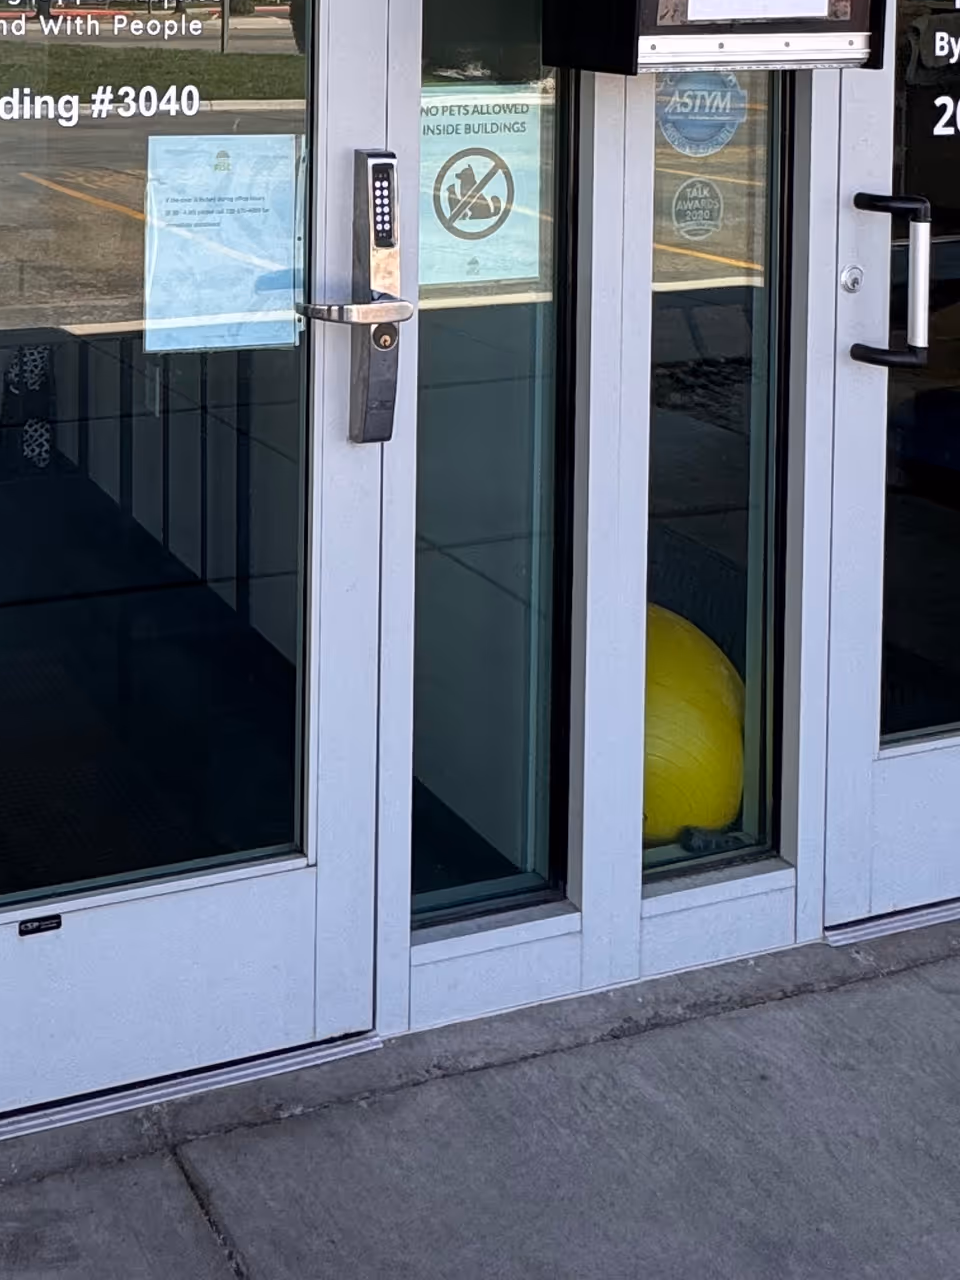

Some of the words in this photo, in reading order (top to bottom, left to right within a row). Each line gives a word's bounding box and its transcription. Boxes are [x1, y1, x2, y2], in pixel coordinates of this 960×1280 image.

[39, 14, 99, 36] With
[114, 14, 202, 40] People
[91, 84, 200, 119] #3040
[420, 105, 439, 117] NO
[441, 104, 470, 116] PETS
[471, 103, 530, 115] ALLOWED
[664, 90, 732, 113] ASTYM
[933, 95, 960, 135] 2
[422, 123, 462, 136] INSIDE
[464, 121, 527, 135] BUILDINGS
[685, 183, 710, 198] TALK
[676, 199, 720, 210] AWARDS
